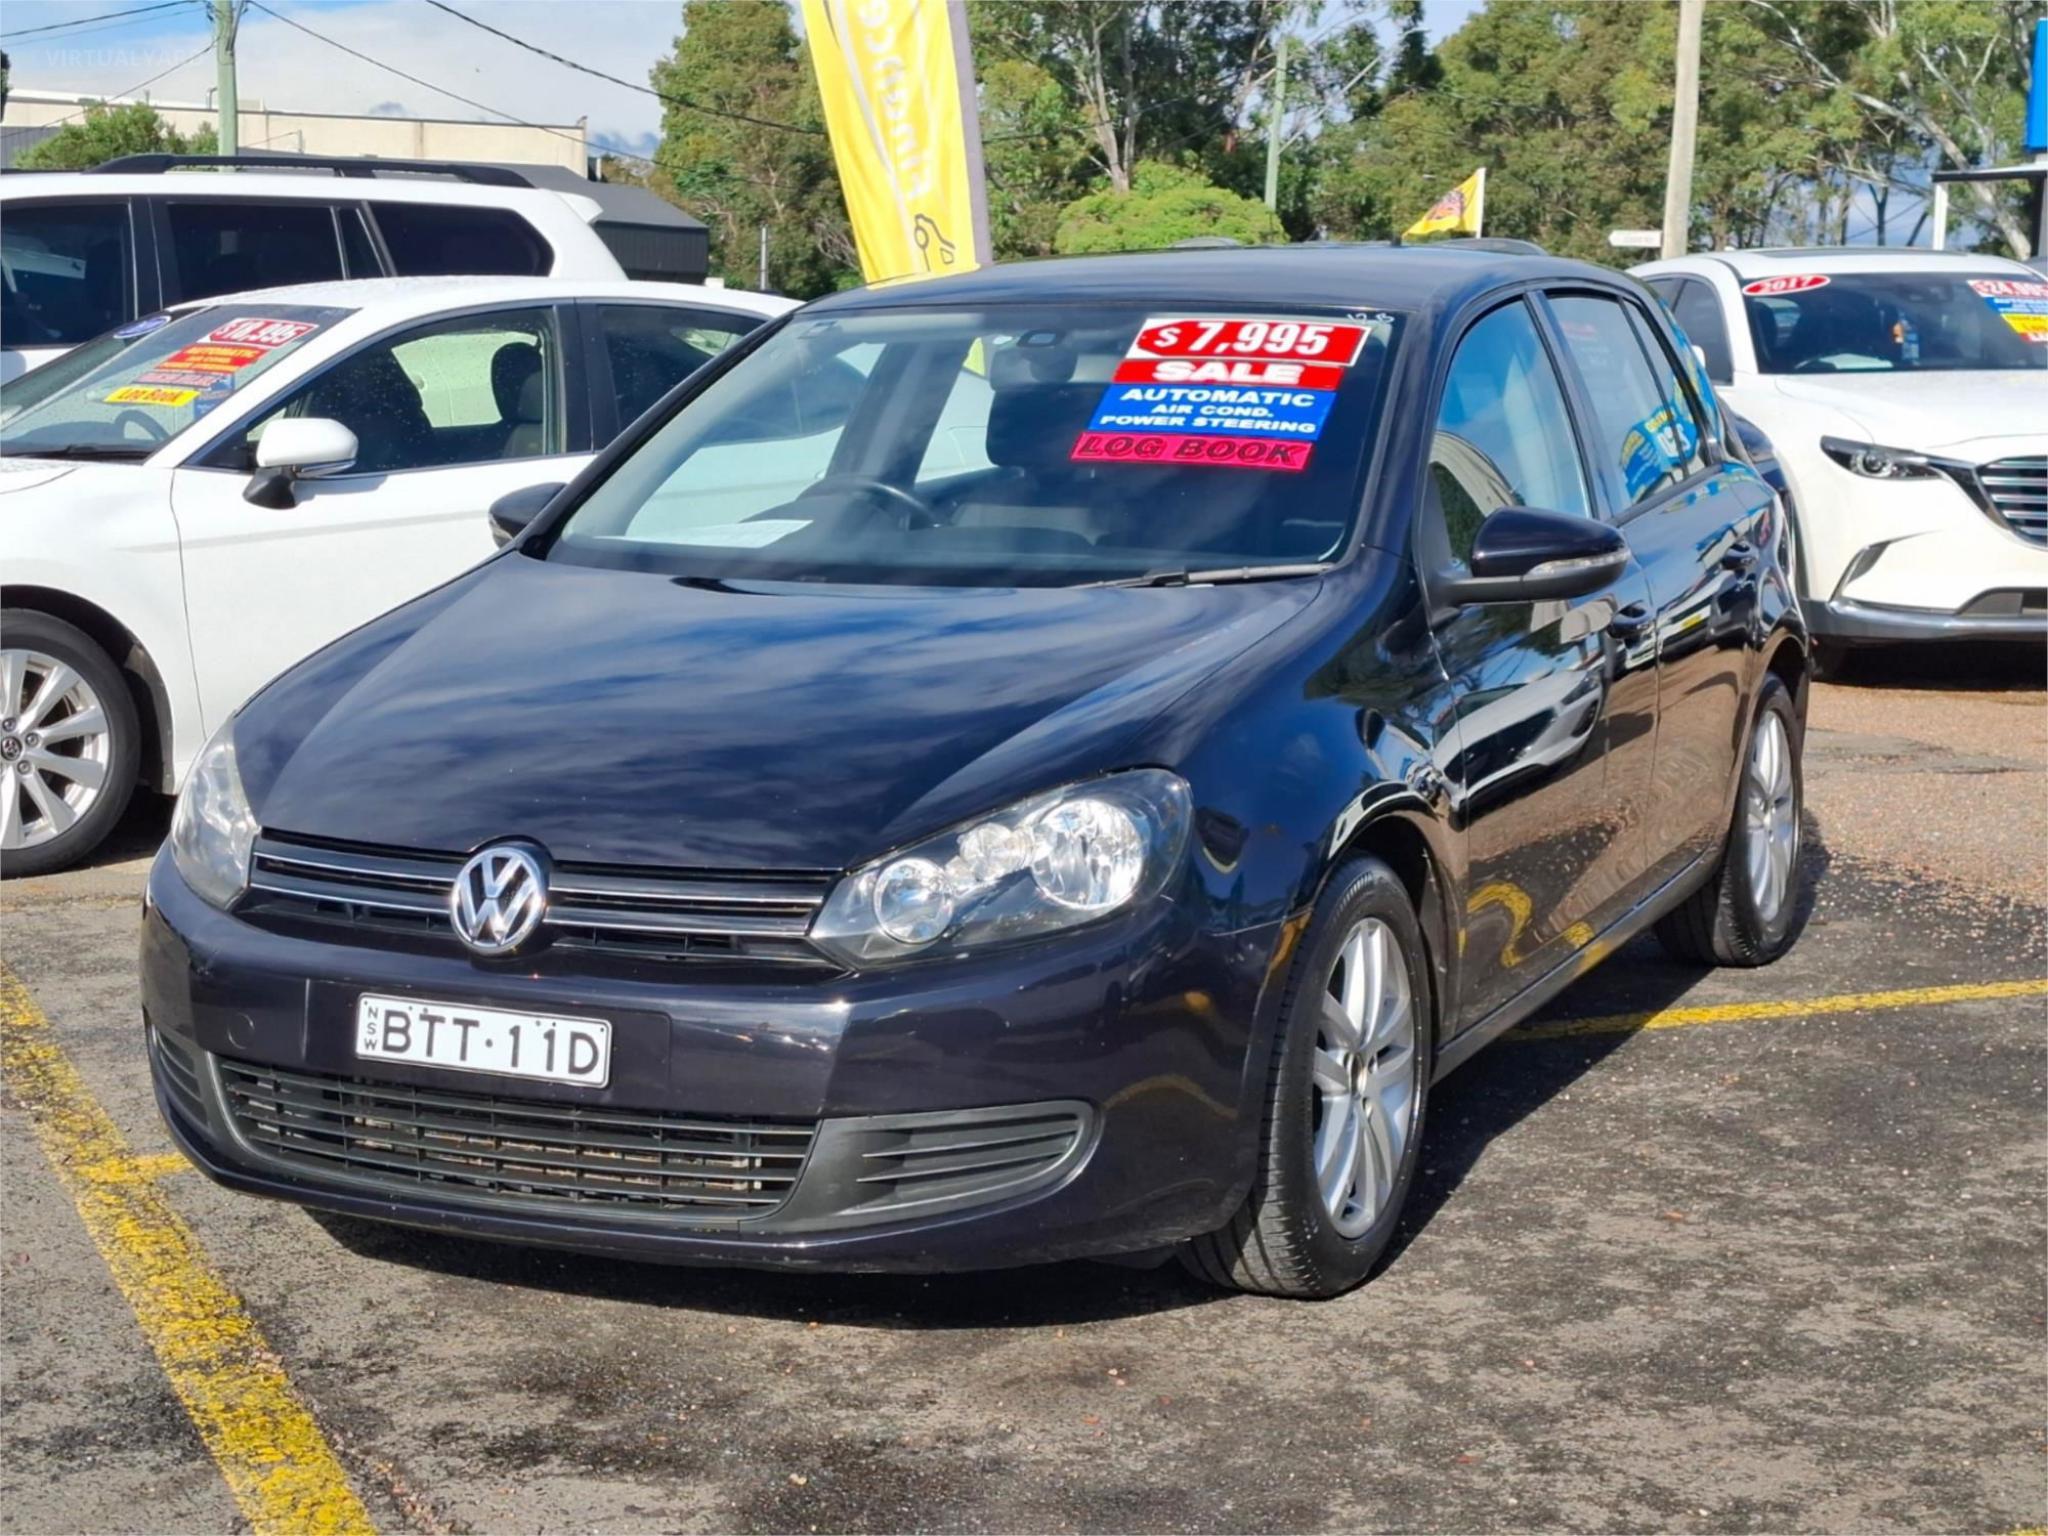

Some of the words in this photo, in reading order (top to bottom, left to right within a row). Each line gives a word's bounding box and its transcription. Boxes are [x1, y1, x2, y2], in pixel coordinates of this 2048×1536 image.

[1758, 275, 1814, 293] 2017
[1152, 360, 1305, 384] SALE
[1120, 388, 1315, 407] AUTOMATIC
[1151, 404, 1193, 415] AIR
[1200, 404, 1274, 418] COND.
[1099, 415, 1184, 427] POWER
[1193, 417, 1316, 434] STEERING
[1079, 436, 1167, 458] LOG
[1175, 438, 1306, 465] BOOK
[364, 1006, 378, 1051] NSW
